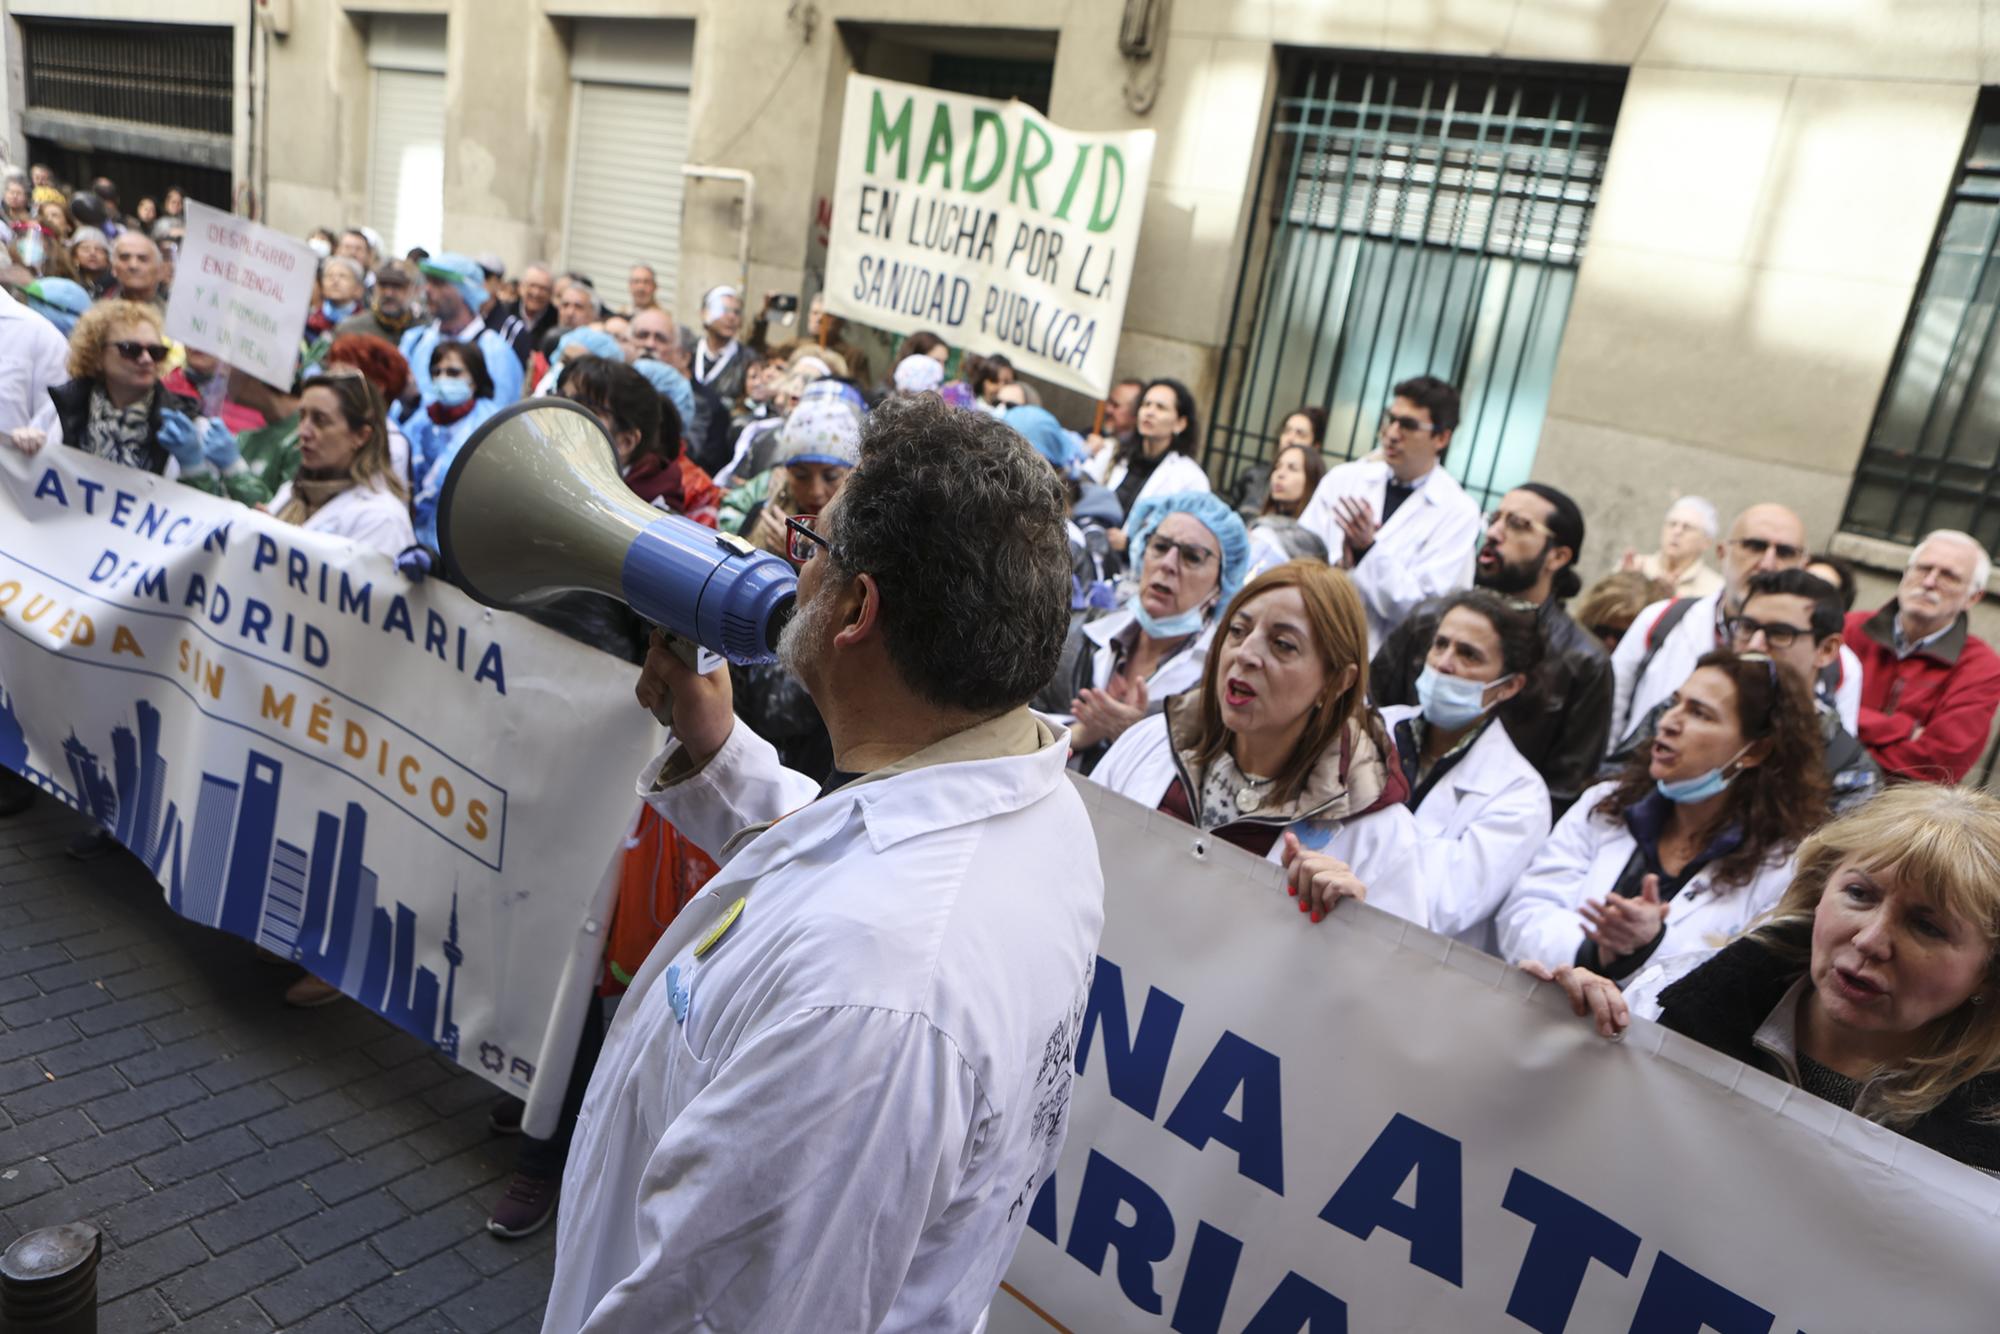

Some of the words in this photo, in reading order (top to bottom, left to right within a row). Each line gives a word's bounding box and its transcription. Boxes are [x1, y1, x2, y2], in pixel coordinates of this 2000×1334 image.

[865, 89, 1126, 233] MADRID
[858, 184, 899, 240] EN
[908, 196, 999, 264] LUCHA
[1006, 220, 1064, 285] POR
[1075, 244, 1116, 300] LA
[854, 255, 970, 327] SANIDAD
[981, 286, 1097, 370] PUBLICA
[35, 468, 234, 554] ATENCN
[253, 532, 507, 697] PRIMARIA
[134, 567, 330, 668] MADRID
[178, 639, 226, 701] SIN
[262, 684, 489, 842] MÉDICOS
